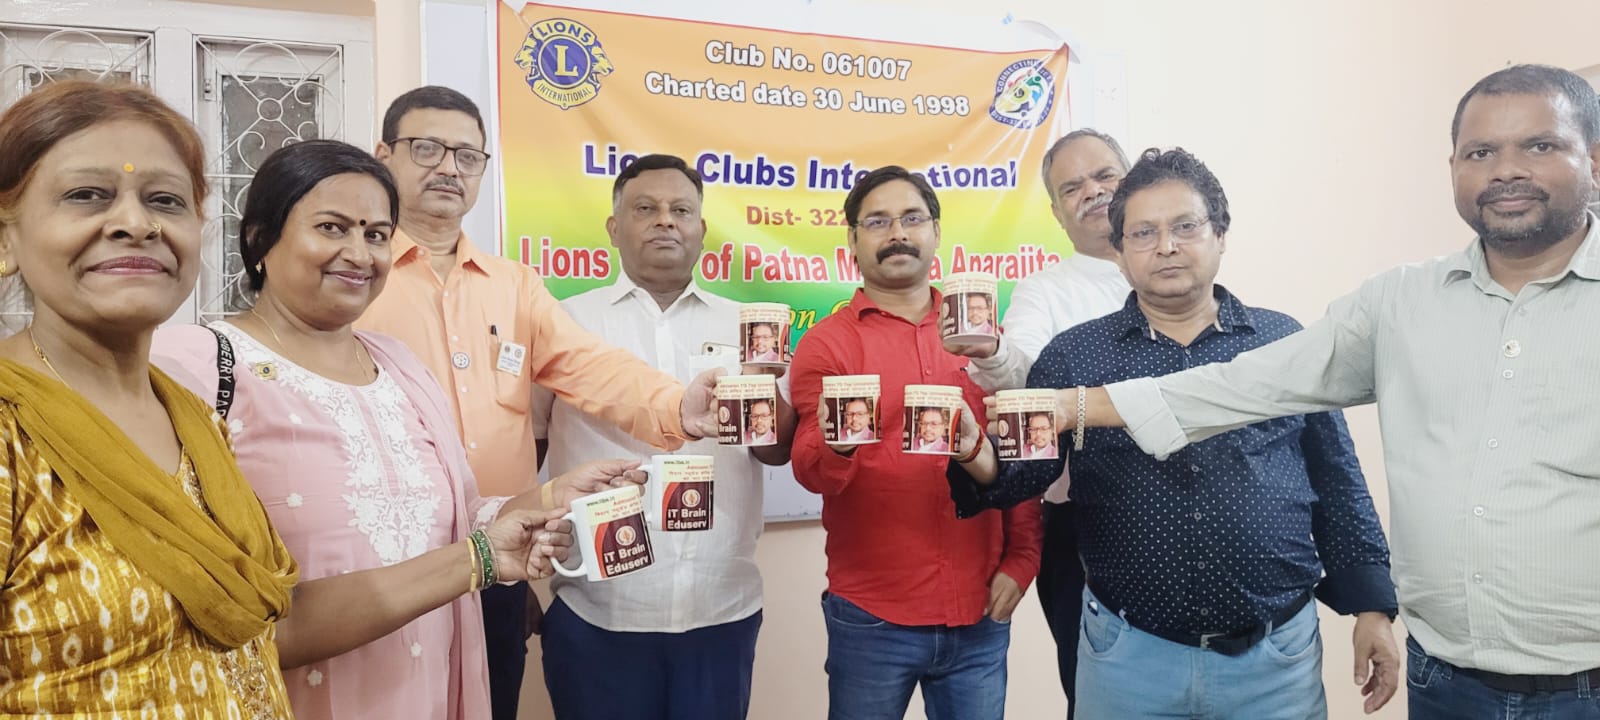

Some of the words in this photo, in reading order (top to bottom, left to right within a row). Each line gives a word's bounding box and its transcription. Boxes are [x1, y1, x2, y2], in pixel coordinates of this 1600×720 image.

[536, 21, 592, 43] LIONS
[554, 44, 579, 77] L
[705, 40, 765, 67] Club
[772, 47, 815, 73] No.
[822, 52, 912, 81] 061007
[537, 83, 593, 102] INTERNATIONAL
[645, 71, 746, 102] Charted
[752, 83, 807, 107] date
[813, 88, 843, 111] 30
[850, 90, 907, 115] June
[913, 95, 970, 117] 1998
[696, 153, 795, 187] Clubs
[746, 205, 802, 226] Dist-
[521, 237, 611, 278] Lions
[701, 242, 734, 281] of
[744, 244, 829, 281] Patna
[681, 507, 707, 519] Brain
[667, 519, 708, 530] Eduserv
[618, 543, 646, 559] Brain
[606, 555, 649, 576] Eduserv
